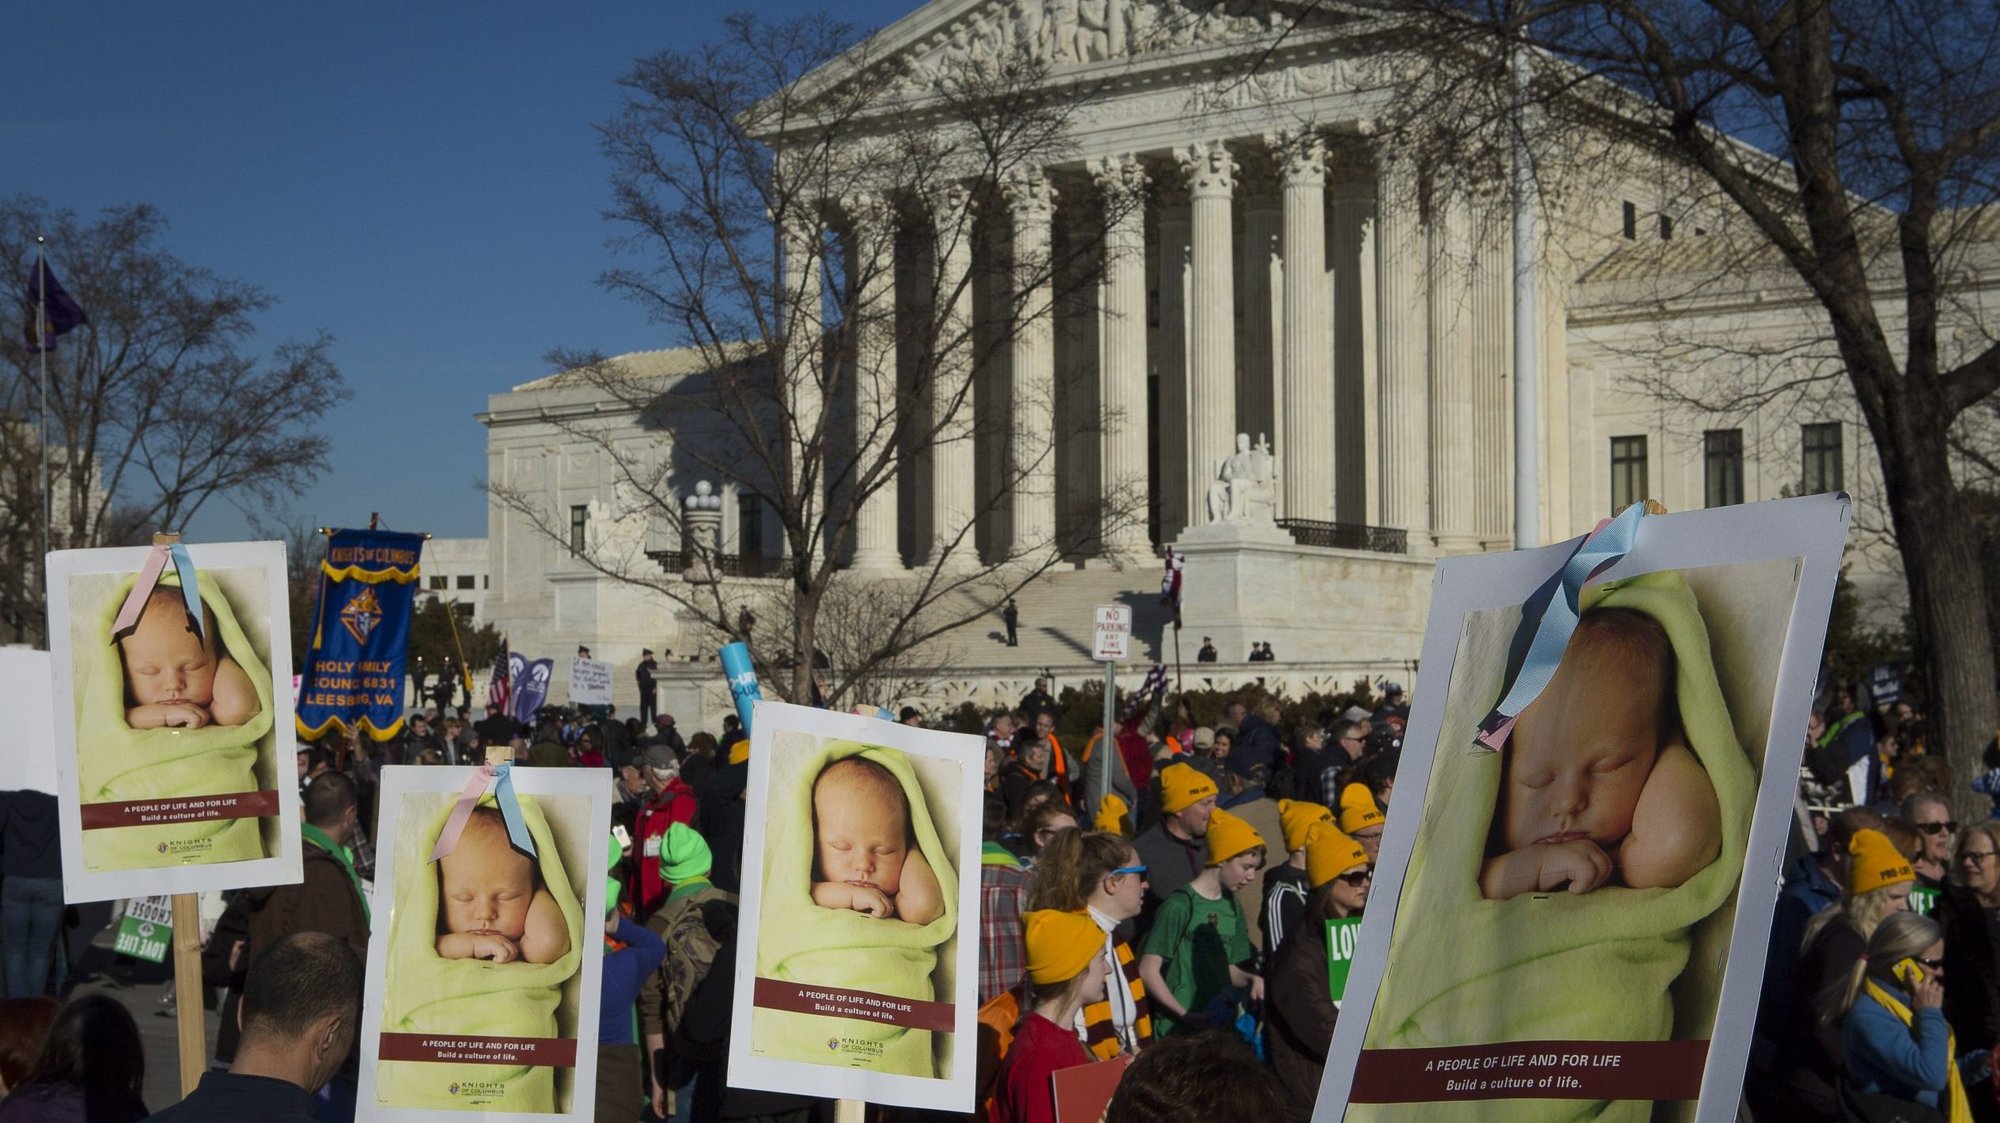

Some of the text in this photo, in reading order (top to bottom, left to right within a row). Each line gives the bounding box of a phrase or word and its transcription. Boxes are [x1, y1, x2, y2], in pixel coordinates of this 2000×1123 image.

[1105, 610, 1120, 621] NO
[1096, 623, 1129, 633] PARKING
[315, 660, 355, 673] HOLY
[363, 677, 396, 689] 6831
[375, 694, 395, 706] VA
[132, 804, 159, 812] PEOPLE
[161, 803, 170, 811] OF
[172, 802, 187, 810] LIFE
[207, 799, 221, 807] FOR
[222, 798, 237, 806] LIFE
[169, 812, 195, 820] culture
[197, 810, 205, 818] of
[131, 901, 171, 924] CHOOSE
[116, 932, 167, 961] LOVE LIFE
[806, 992, 834, 1001] PEOPLE
[849, 996, 864, 1004] LIFE
[866, 998, 881, 1007] AND
[882, 1001, 896, 1010] FOR
[897, 1004, 912, 1012] LIFE
[815, 1003, 835, 1012] Build
[844, 1007, 871, 1016] culture
[872, 1010, 880, 1018] of
[881, 1011, 895, 1020] life.
[429, 1040, 455, 1048] PEOPLE
[485, 1042, 502, 1050] AND
[520, 1043, 535, 1051] LIFE
[841, 1038, 883, 1048] KNIGHTS
[1425, 1054, 1621, 1071] A PEOPLE OF LIFE AND FOR LIFE
[1446, 1076, 1583, 1091] Build a culture of life.
